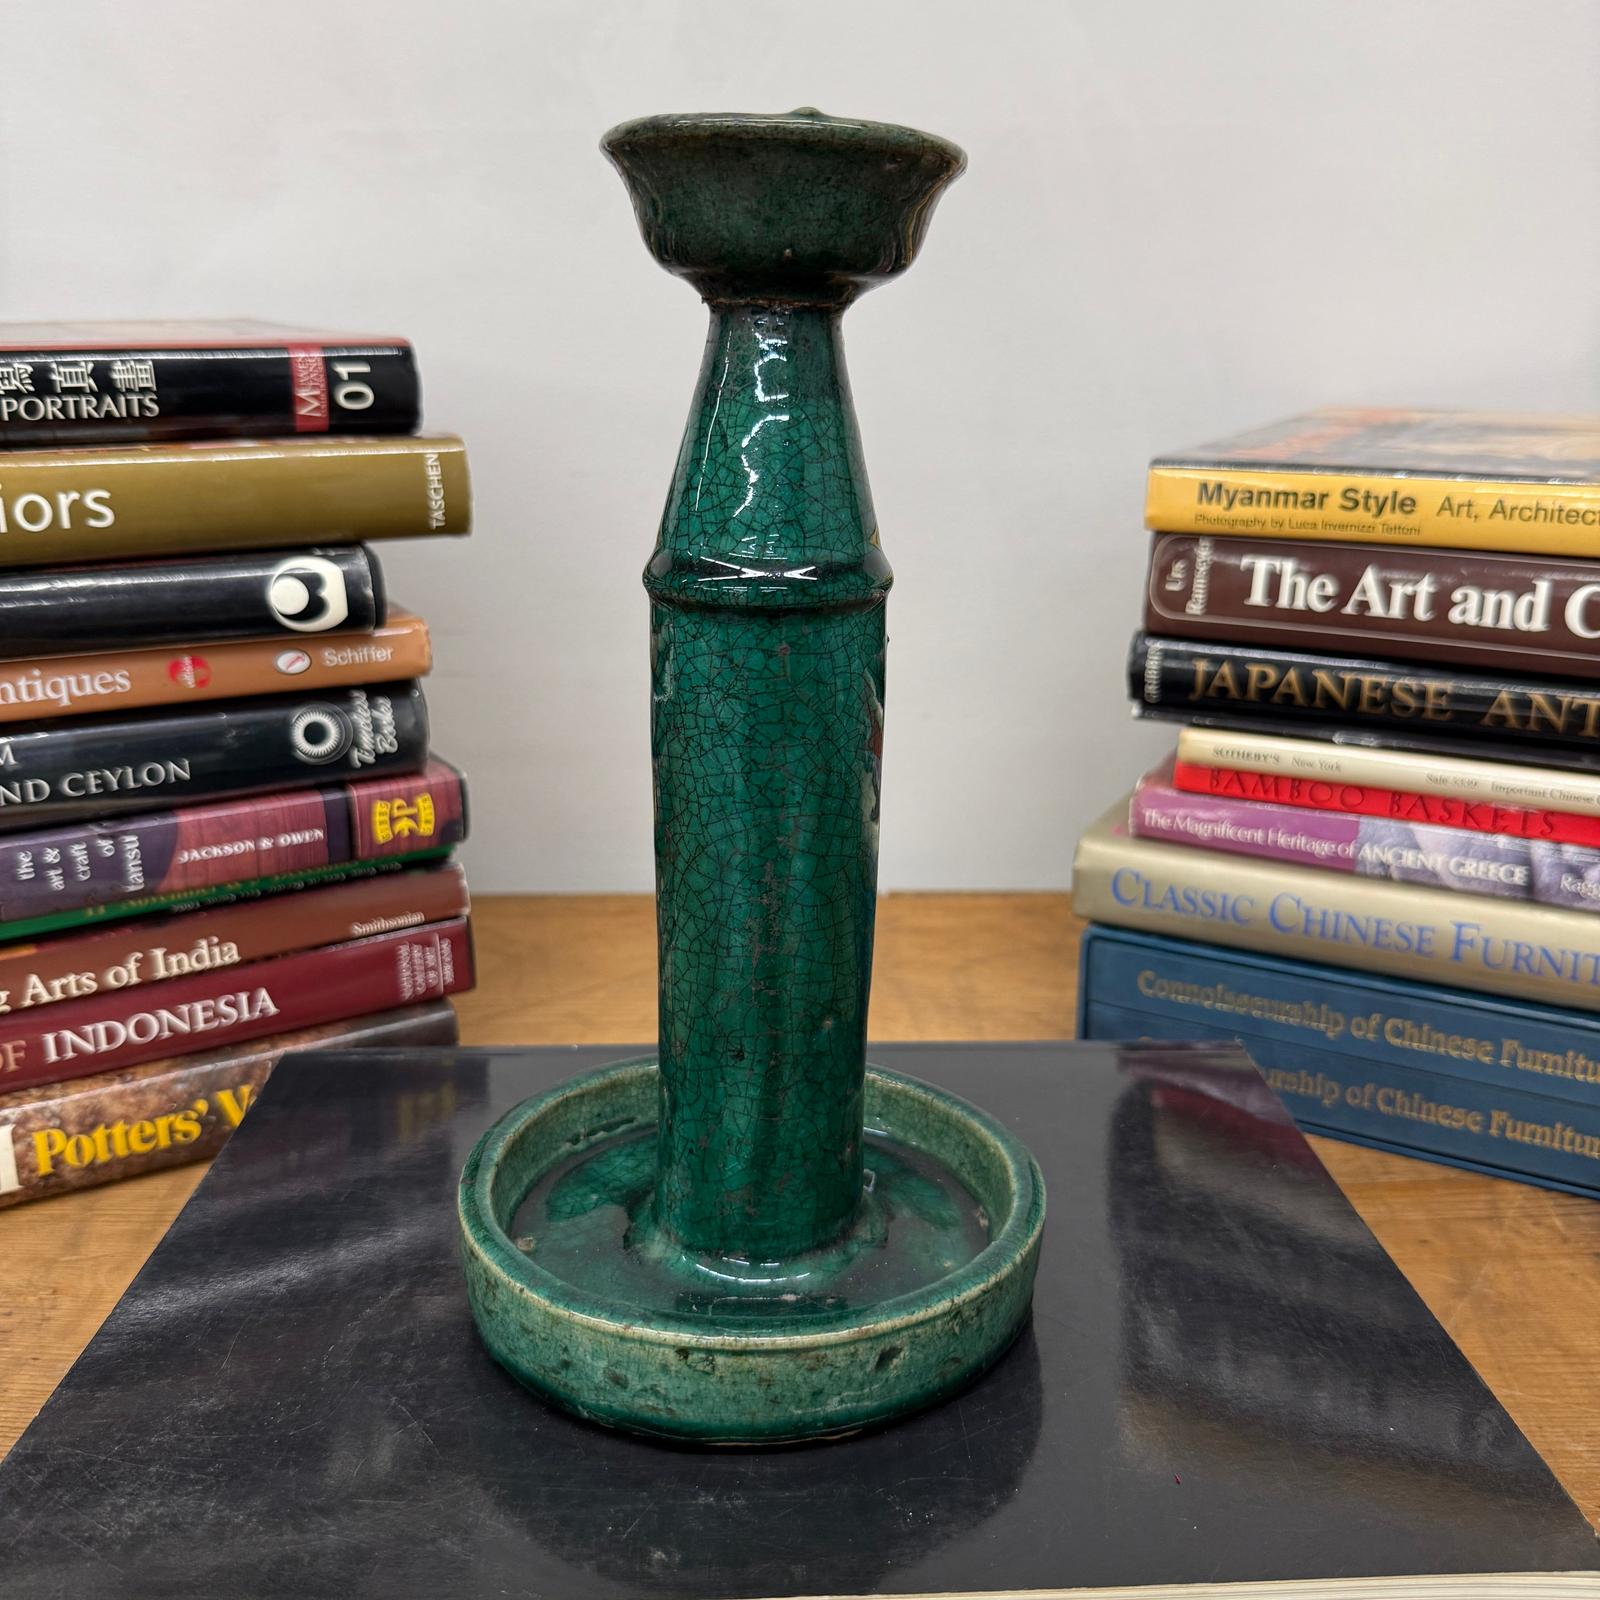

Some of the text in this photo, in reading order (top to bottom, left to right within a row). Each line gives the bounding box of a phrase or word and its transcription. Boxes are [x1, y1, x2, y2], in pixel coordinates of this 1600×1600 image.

[0, 393, 160, 421] PORTRAITS
[333, 361, 374, 410] 01
[424, 453, 446, 529] TASCHEN
[1196, 481, 1600, 527] Myanmar Style Art, Architec
[1194, 513, 1266, 528] Photography
[1270, 515, 1284, 529] by
[1288, 517, 1318, 530] Luca
[1380, 523, 1421, 536] Tettoni
[1240, 553, 1600, 639] The Art and C
[321, 645, 394, 667] Schiffer
[0, 668, 131, 707] ntiques
[1188, 657, 1454, 722] JAPANESE
[1480, 689, 1600, 738] ANT
[60, 757, 191, 797] CEYLON
[1212, 747, 1280, 764] SOTHEBY'S
[1292, 757, 1314, 769] New
[1318, 758, 1342, 772] York
[1425, 772, 1449, 785] Sale
[1490, 781, 1546, 798] Important
[1550, 788, 1595, 805] Chinese
[1209, 767, 1557, 836] BAMBOO BASKETS
[16, 850, 36, 881] the
[41, 846, 66, 892] art &
[69, 841, 91, 881] craft
[95, 839, 115, 858] of
[178, 828, 325, 864] JACKSON & OWEN
[1144, 806, 1172, 828] The
[1173, 814, 1265, 843] Magnificent
[1268, 827, 1336, 858] Heritage
[1337, 840, 1356, 858] of
[1358, 842, 1448, 872] ANCIENT
[1449, 855, 1529, 886] GREECE
[351, 911, 425, 937] Smithsonian
[1111, 867, 1256, 925] CLASSIC
[1269, 897, 1436, 958] CHINESE
[21, 971, 98, 1007] Arts
[105, 951, 144, 990] of
[151, 936, 241, 980] India
[0, 987, 280, 1073] F INDONESIA
[1350, 1012, 1384, 1041] of
[1384, 1017, 1496, 1065] Chinese
[1345, 1082, 1377, 1109] of
[1376, 1086, 1484, 1134] Chinese
